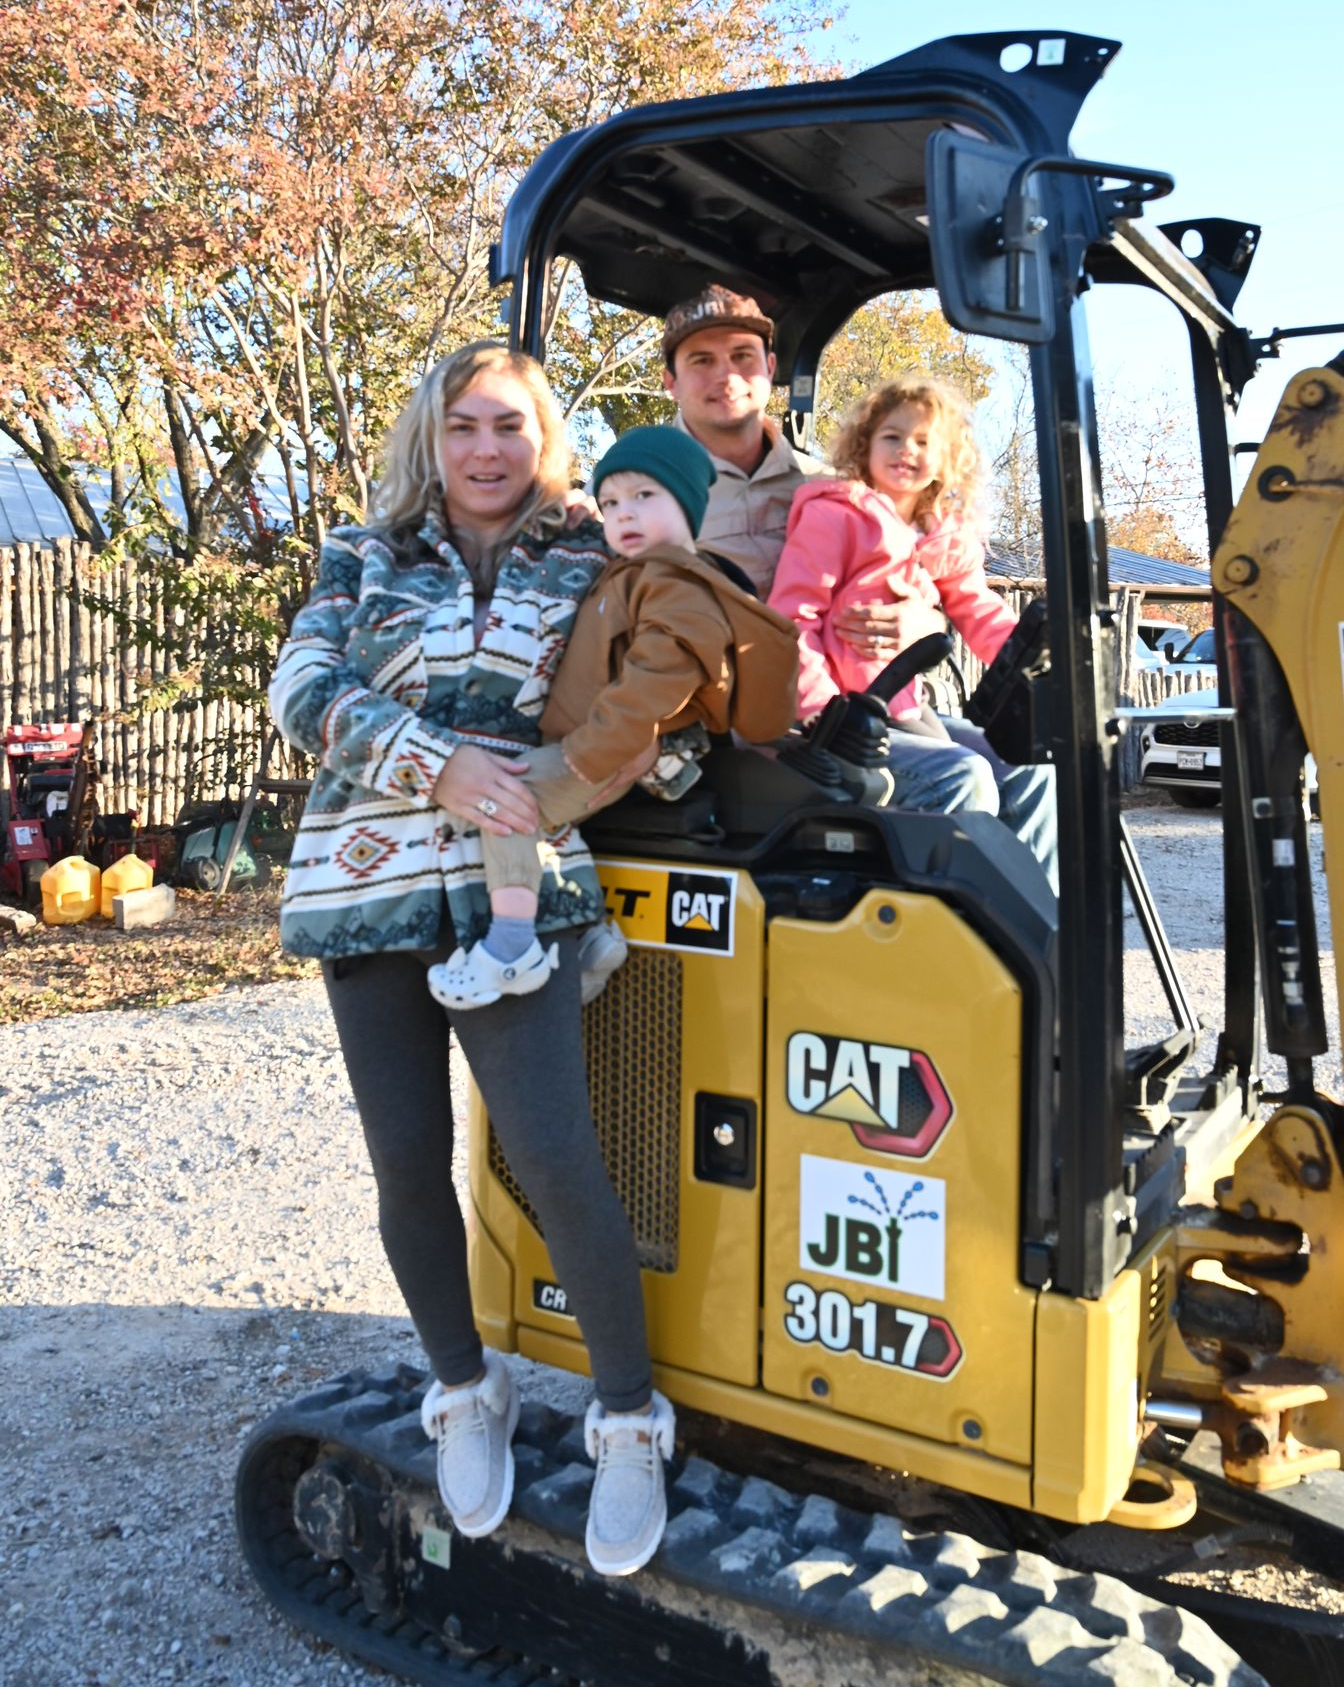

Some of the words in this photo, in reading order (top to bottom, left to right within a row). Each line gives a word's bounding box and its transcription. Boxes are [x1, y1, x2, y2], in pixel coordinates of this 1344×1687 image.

[671, 889, 725, 931] CAT
[787, 1032, 910, 1130] CAT
[806, 1212, 902, 1283] JBI
[786, 1281, 929, 1369] 301.7
